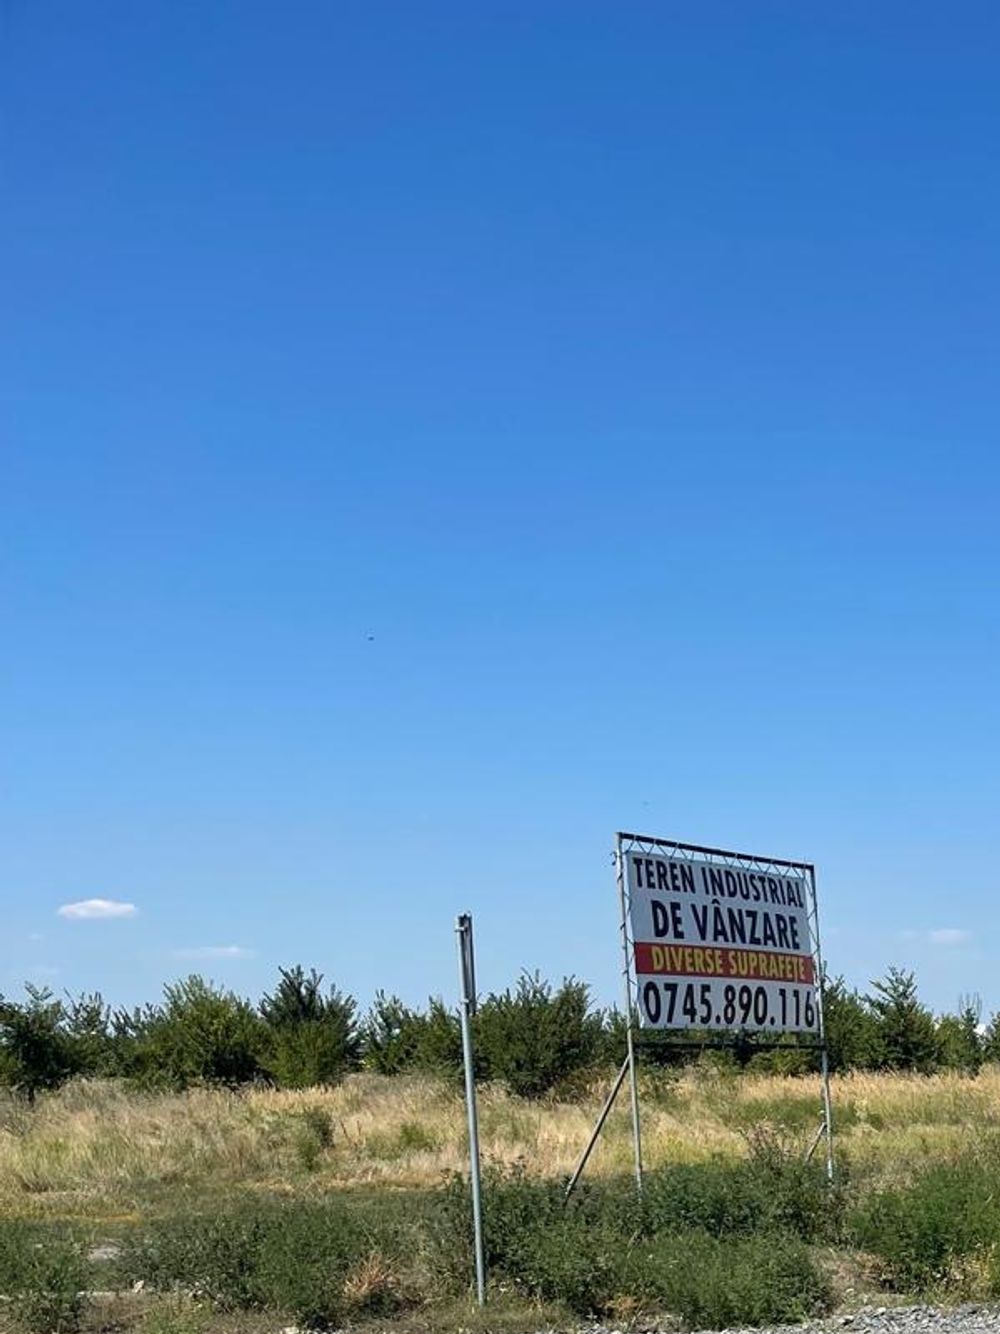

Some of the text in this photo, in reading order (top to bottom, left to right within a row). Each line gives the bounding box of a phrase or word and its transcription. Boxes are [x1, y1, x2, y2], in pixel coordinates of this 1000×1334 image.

[633, 857, 803, 908] TEREN INDUSTRIAL
[651, 899, 800, 950] DE VÂNZARE
[652, 946, 723, 974] DIVERSE
[643, 981, 815, 1028] 0745.890.116
